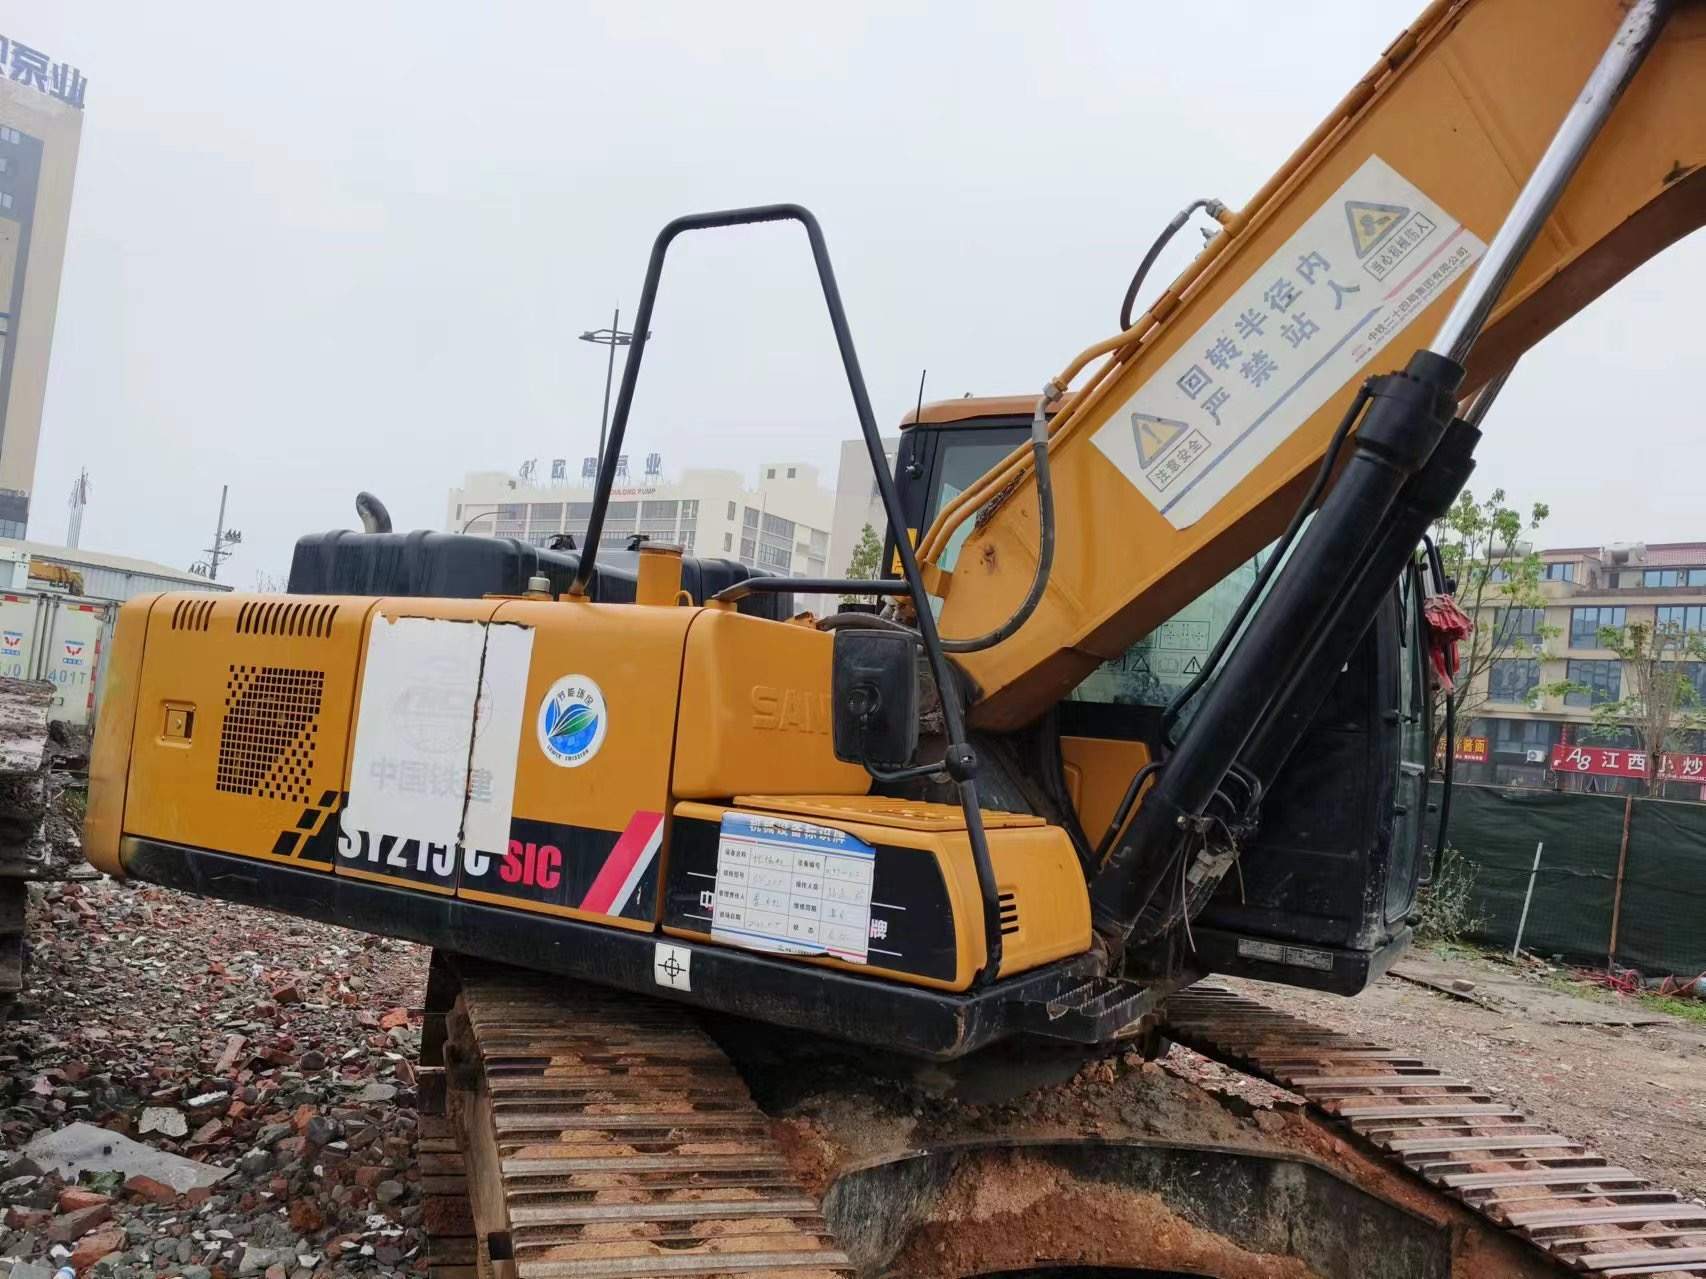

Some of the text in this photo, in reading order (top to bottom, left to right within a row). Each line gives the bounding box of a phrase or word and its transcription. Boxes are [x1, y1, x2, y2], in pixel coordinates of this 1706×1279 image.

[1371, 220, 1429, 273] 当心机械伤人
[1368, 246, 1469, 341] 中铁二十四局集团有限公司
[1176, 251, 1331, 400] 回转半径内
[1201, 280, 1360, 426] 严禁站人
[1155, 440, 1202, 483] 注意安全
[751, 685, 831, 735] SAN
[1601, 750, 1704, 776] 江西小炒
[500, 839, 562, 889] SIC
